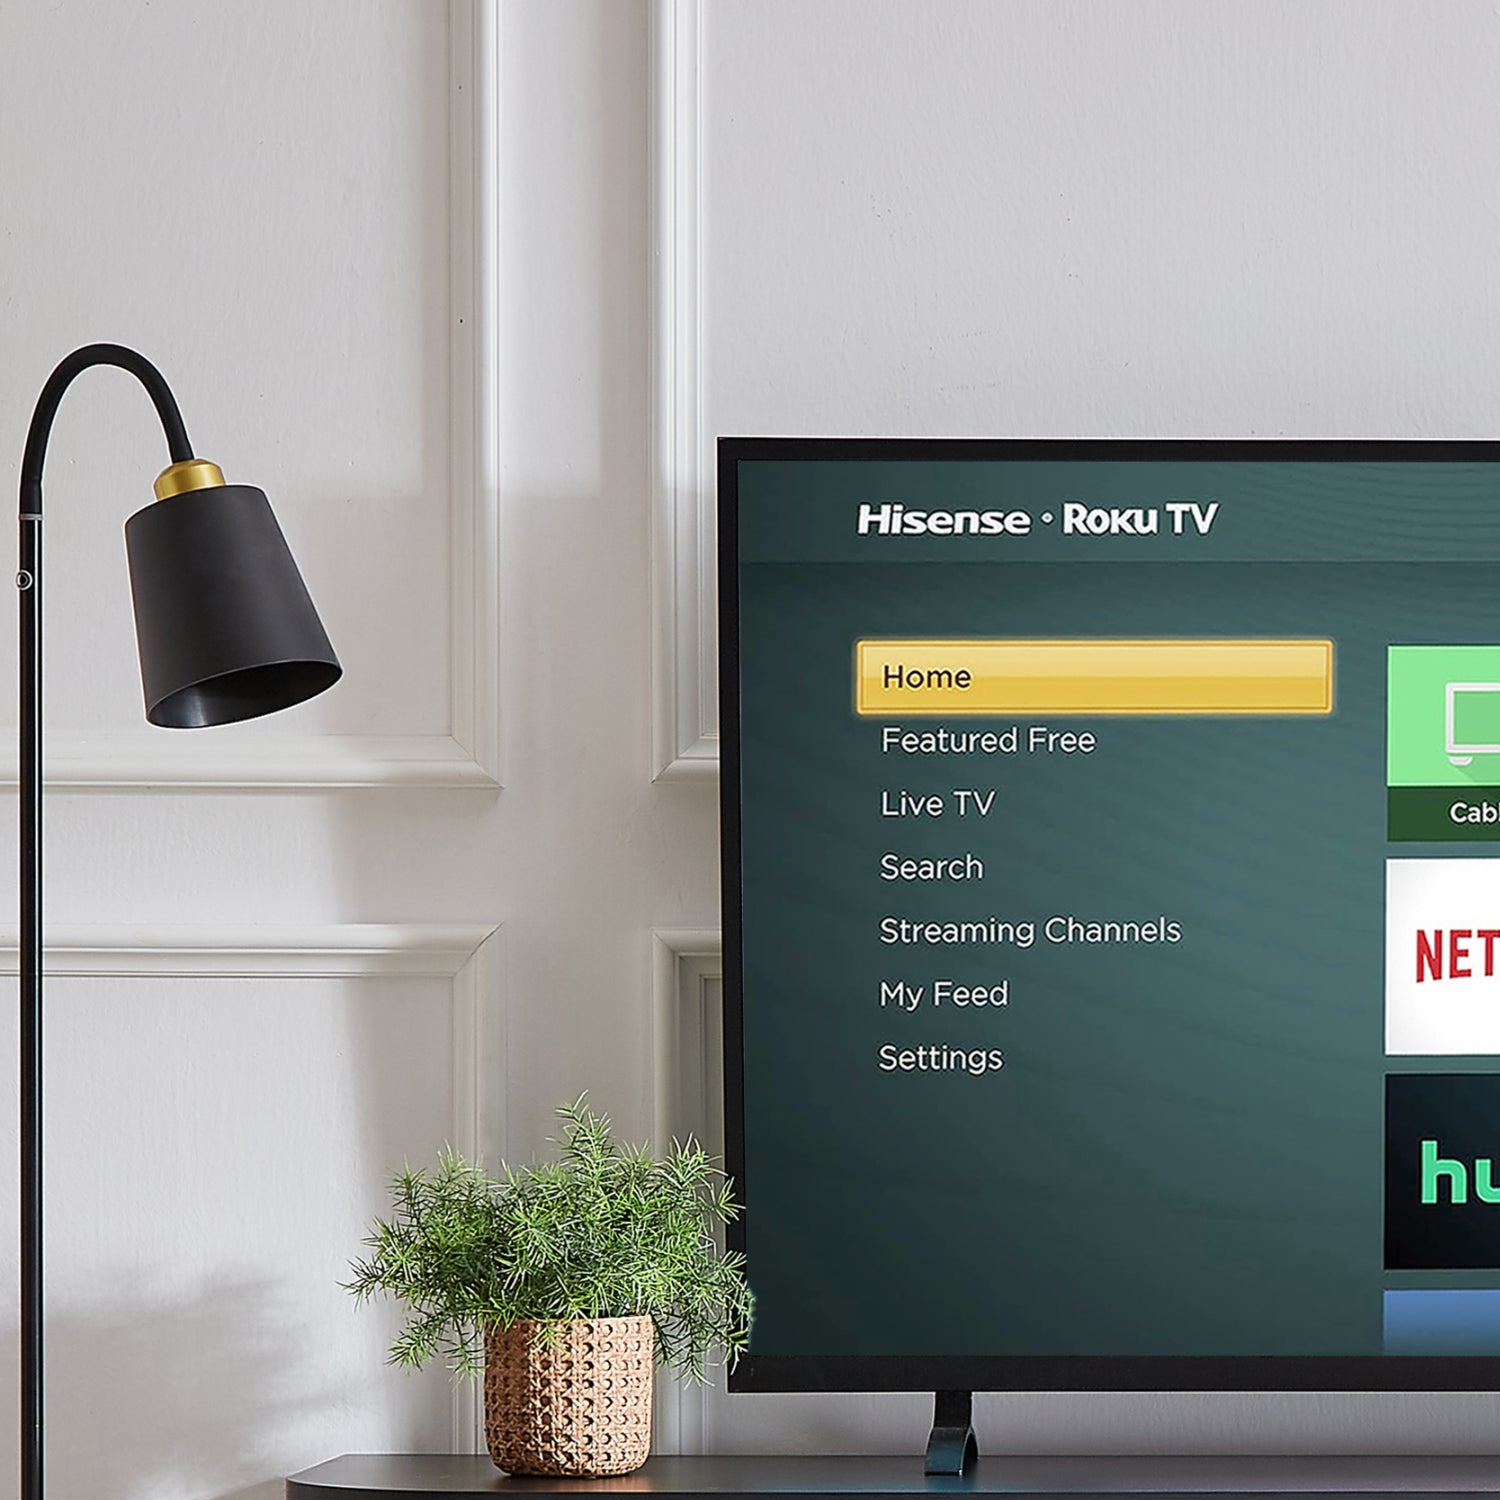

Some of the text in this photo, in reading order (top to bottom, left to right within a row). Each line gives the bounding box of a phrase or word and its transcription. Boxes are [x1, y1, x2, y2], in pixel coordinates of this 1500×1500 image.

[857, 502, 1219, 535] Hisense Roku TV
[882, 664, 972, 691] Home
[881, 725, 1097, 755] Featured Free
[881, 789, 996, 817] Live TV
[879, 852, 984, 881] Search
[879, 915, 1182, 949] Streaming Channels
[880, 979, 1009, 1013] My Feed
[878, 1043, 1004, 1076] Settings
